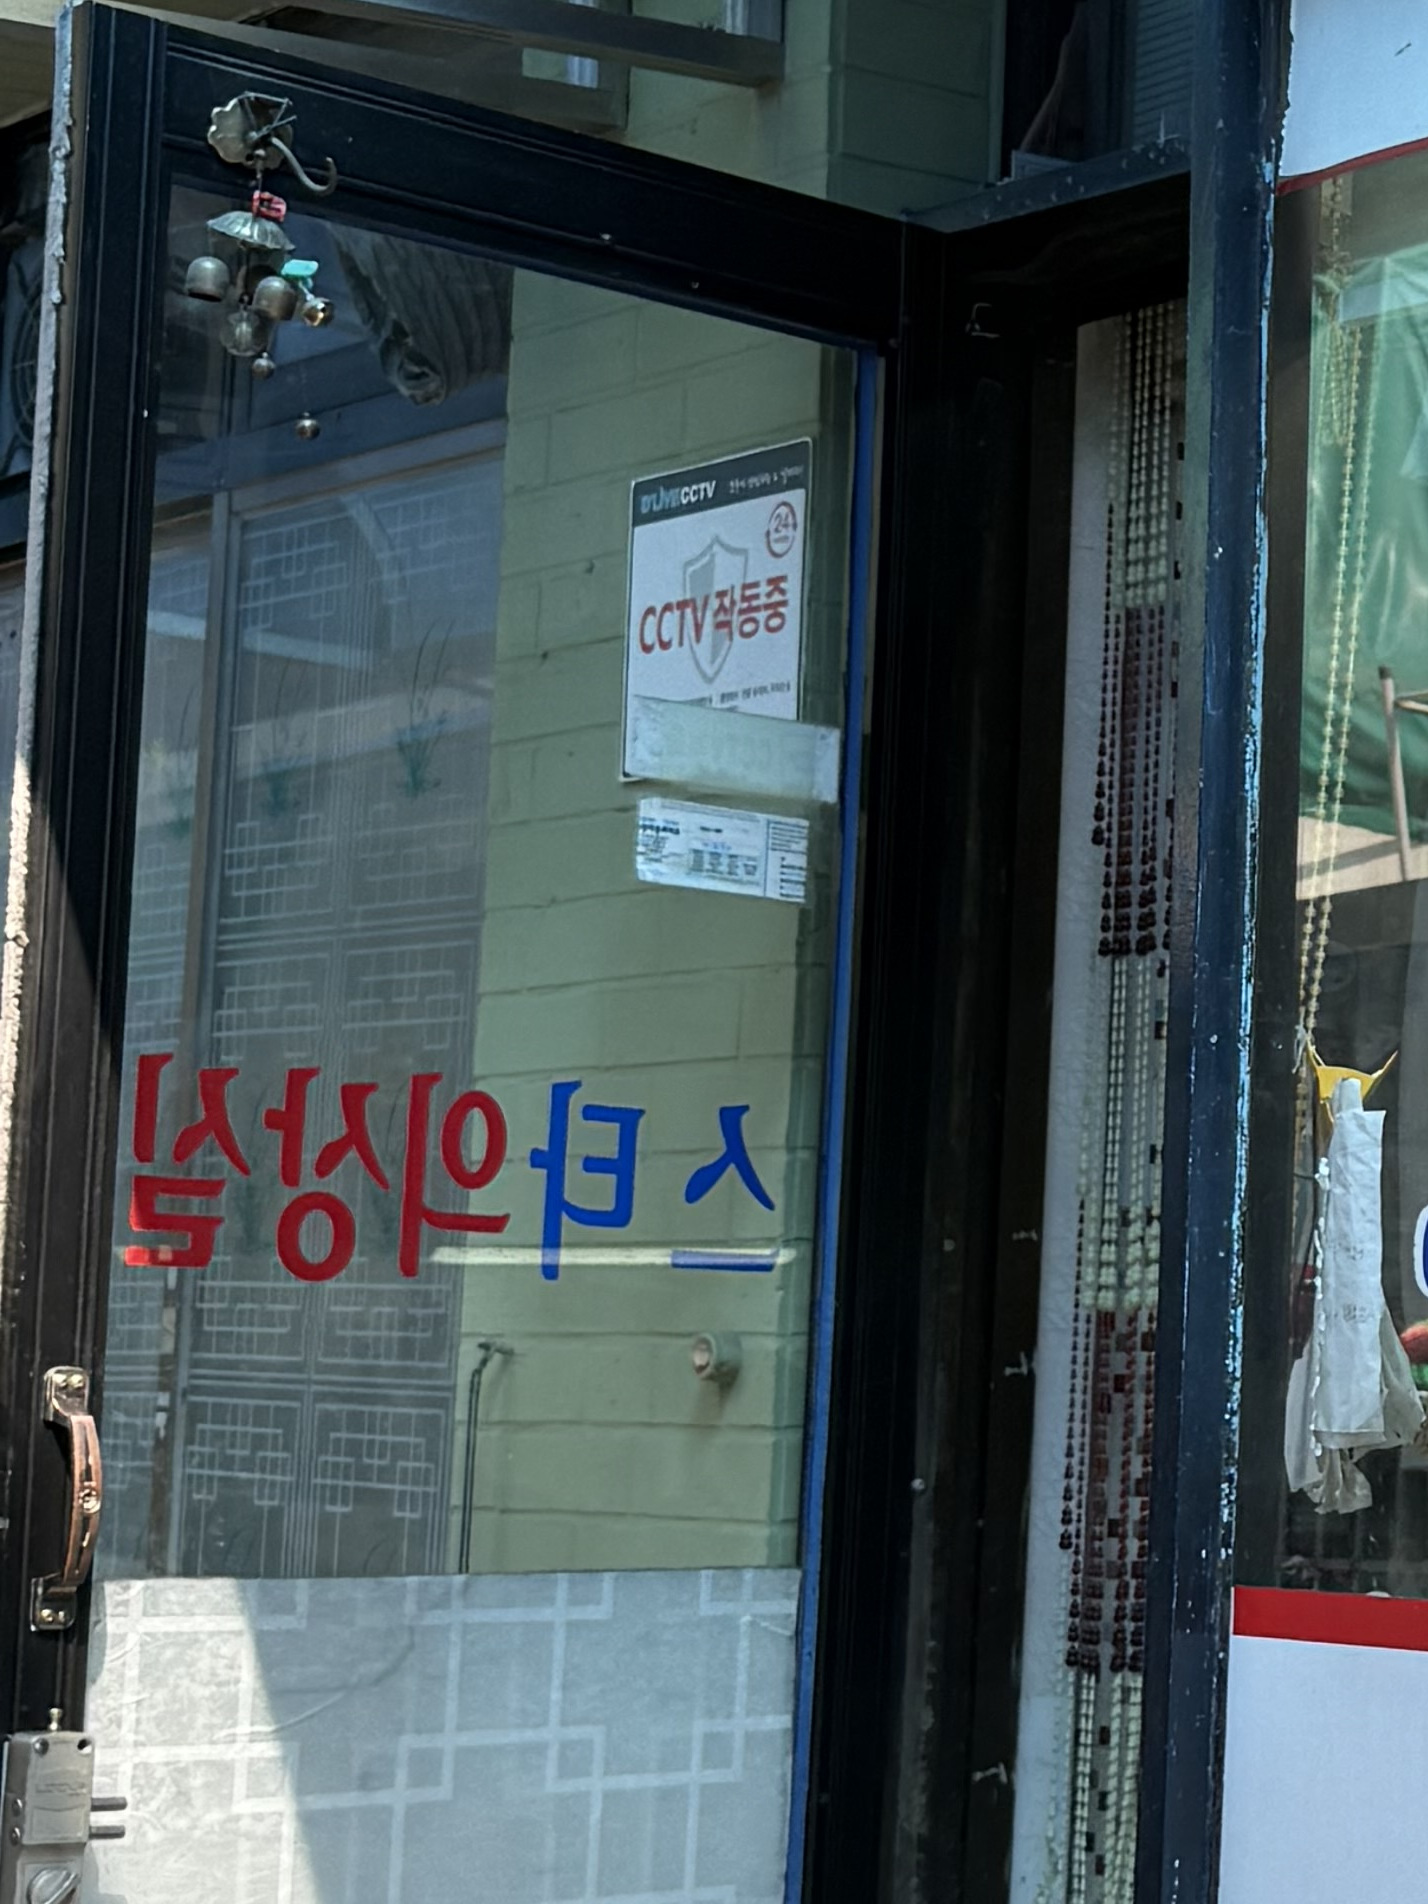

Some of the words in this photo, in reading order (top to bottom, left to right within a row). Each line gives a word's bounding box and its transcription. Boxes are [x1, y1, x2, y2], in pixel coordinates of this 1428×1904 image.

[680, 480, 717, 503] CCTV
[639, 596, 709, 654] CCTV
[711, 574, 789, 643] 작동중
